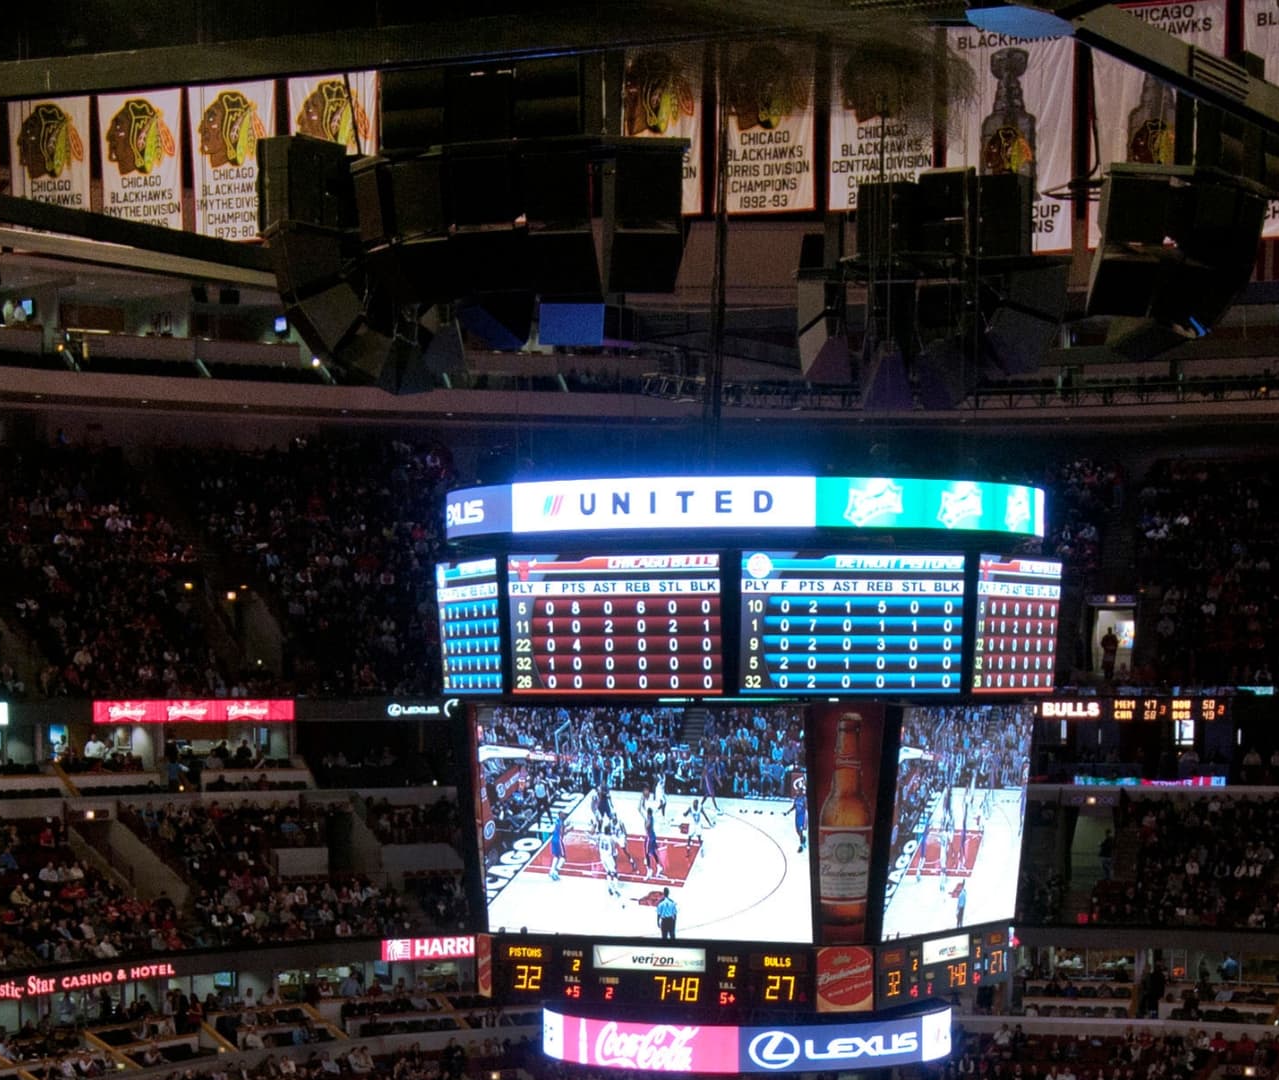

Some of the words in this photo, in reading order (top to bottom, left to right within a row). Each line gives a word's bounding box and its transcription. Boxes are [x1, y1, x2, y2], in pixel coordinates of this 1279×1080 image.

[739, 130, 791, 146] CHICAGO
[213, 167, 255, 181] CHICAGO
[763, 160, 810, 177] DIVISION
[120, 175, 162, 189] CHICAGO
[731, 178, 798, 193] CHAMPIONS
[110, 188, 174, 204] BLACKHAWKS
[740, 194, 788, 209] 1992-93
[578, 489, 775, 516] UNITED
[511, 583, 534, 595] PLY
[544, 582, 551, 593] F
[561, 582, 586, 594] PTS
[592, 582, 618, 593] AST
[624, 581, 650, 593] REB
[658, 581, 683, 592] STL
[690, 580, 717, 592] BLK
[744, 580, 769, 592] PLY
[780, 581, 788, 592] F
[799, 580, 825, 592] PTS
[832, 580, 859, 592] AST
[866, 580, 893, 592] REB
[902, 580, 927, 592] STL
[933, 580, 960, 592] BLK
[517, 602, 527, 615] 5
[545, 601, 555, 615] 0
[571, 601, 581, 615] 8
[603, 601, 613, 614] 0
[636, 600, 646, 614] 6
[668, 600, 677, 614] 0
[701, 600, 711, 613] 0
[1041, 701, 1100, 718] BULLS
[414, 936, 475, 957] HARRI
[508, 946, 542, 959] PISTONS
[572, 959, 580, 972] 2
[631, 953, 675, 967] verizon
[763, 956, 792, 969] BULLS
[513, 965, 542, 991] 32
[727, 965, 736, 978] 2
[27, 975, 56, 996] Star
[61, 971, 113, 989] CASINO
[116, 969, 127, 980] &
[130, 964, 176, 979] HOTEL
[604, 986, 614, 1000] 2
[653, 975, 699, 1002] 7:48
[765, 975, 795, 1001] 27
[805, 1031, 919, 1060] LEXUS
